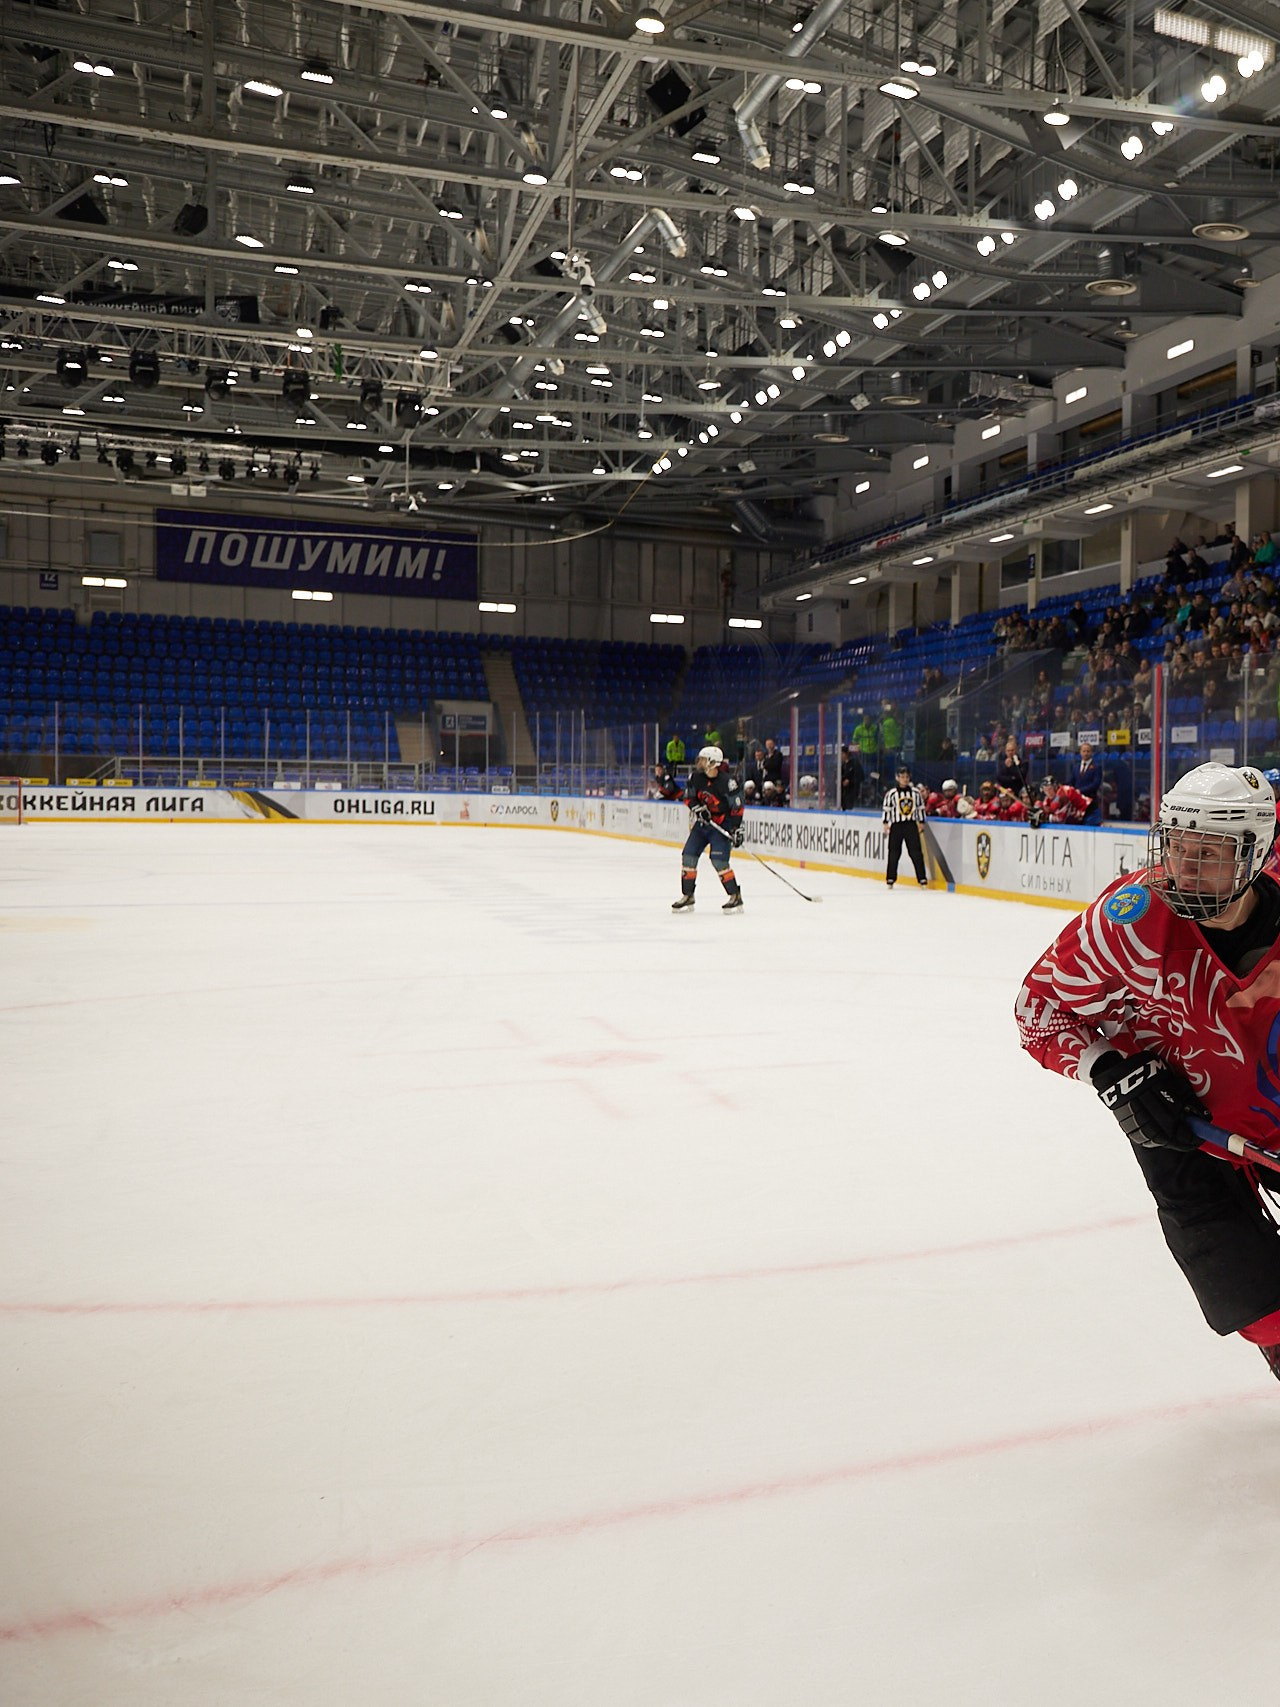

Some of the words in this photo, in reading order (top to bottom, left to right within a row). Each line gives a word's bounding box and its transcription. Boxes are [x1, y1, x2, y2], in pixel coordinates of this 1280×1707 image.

[184, 530, 447, 581] ПОШУМИМ!
[0, 790, 136, 812] ОККЕЙНАЯ
[146, 796, 204, 812] ЛИГА
[333, 798, 435, 816] OHLIGA.RU
[1170, 805, 1200, 814] BAUER
[742, 820, 793, 848] ИЦЕРСКАЯ
[796, 815, 860, 857] ХОККЕЙНАЯ
[864, 830, 888, 860] ЛИГ
[1019, 834, 1073, 868] ЛИГА
[1021, 873, 1072, 894] СИЛЬНЫХ
[1100, 1059, 1167, 1107] CCM
